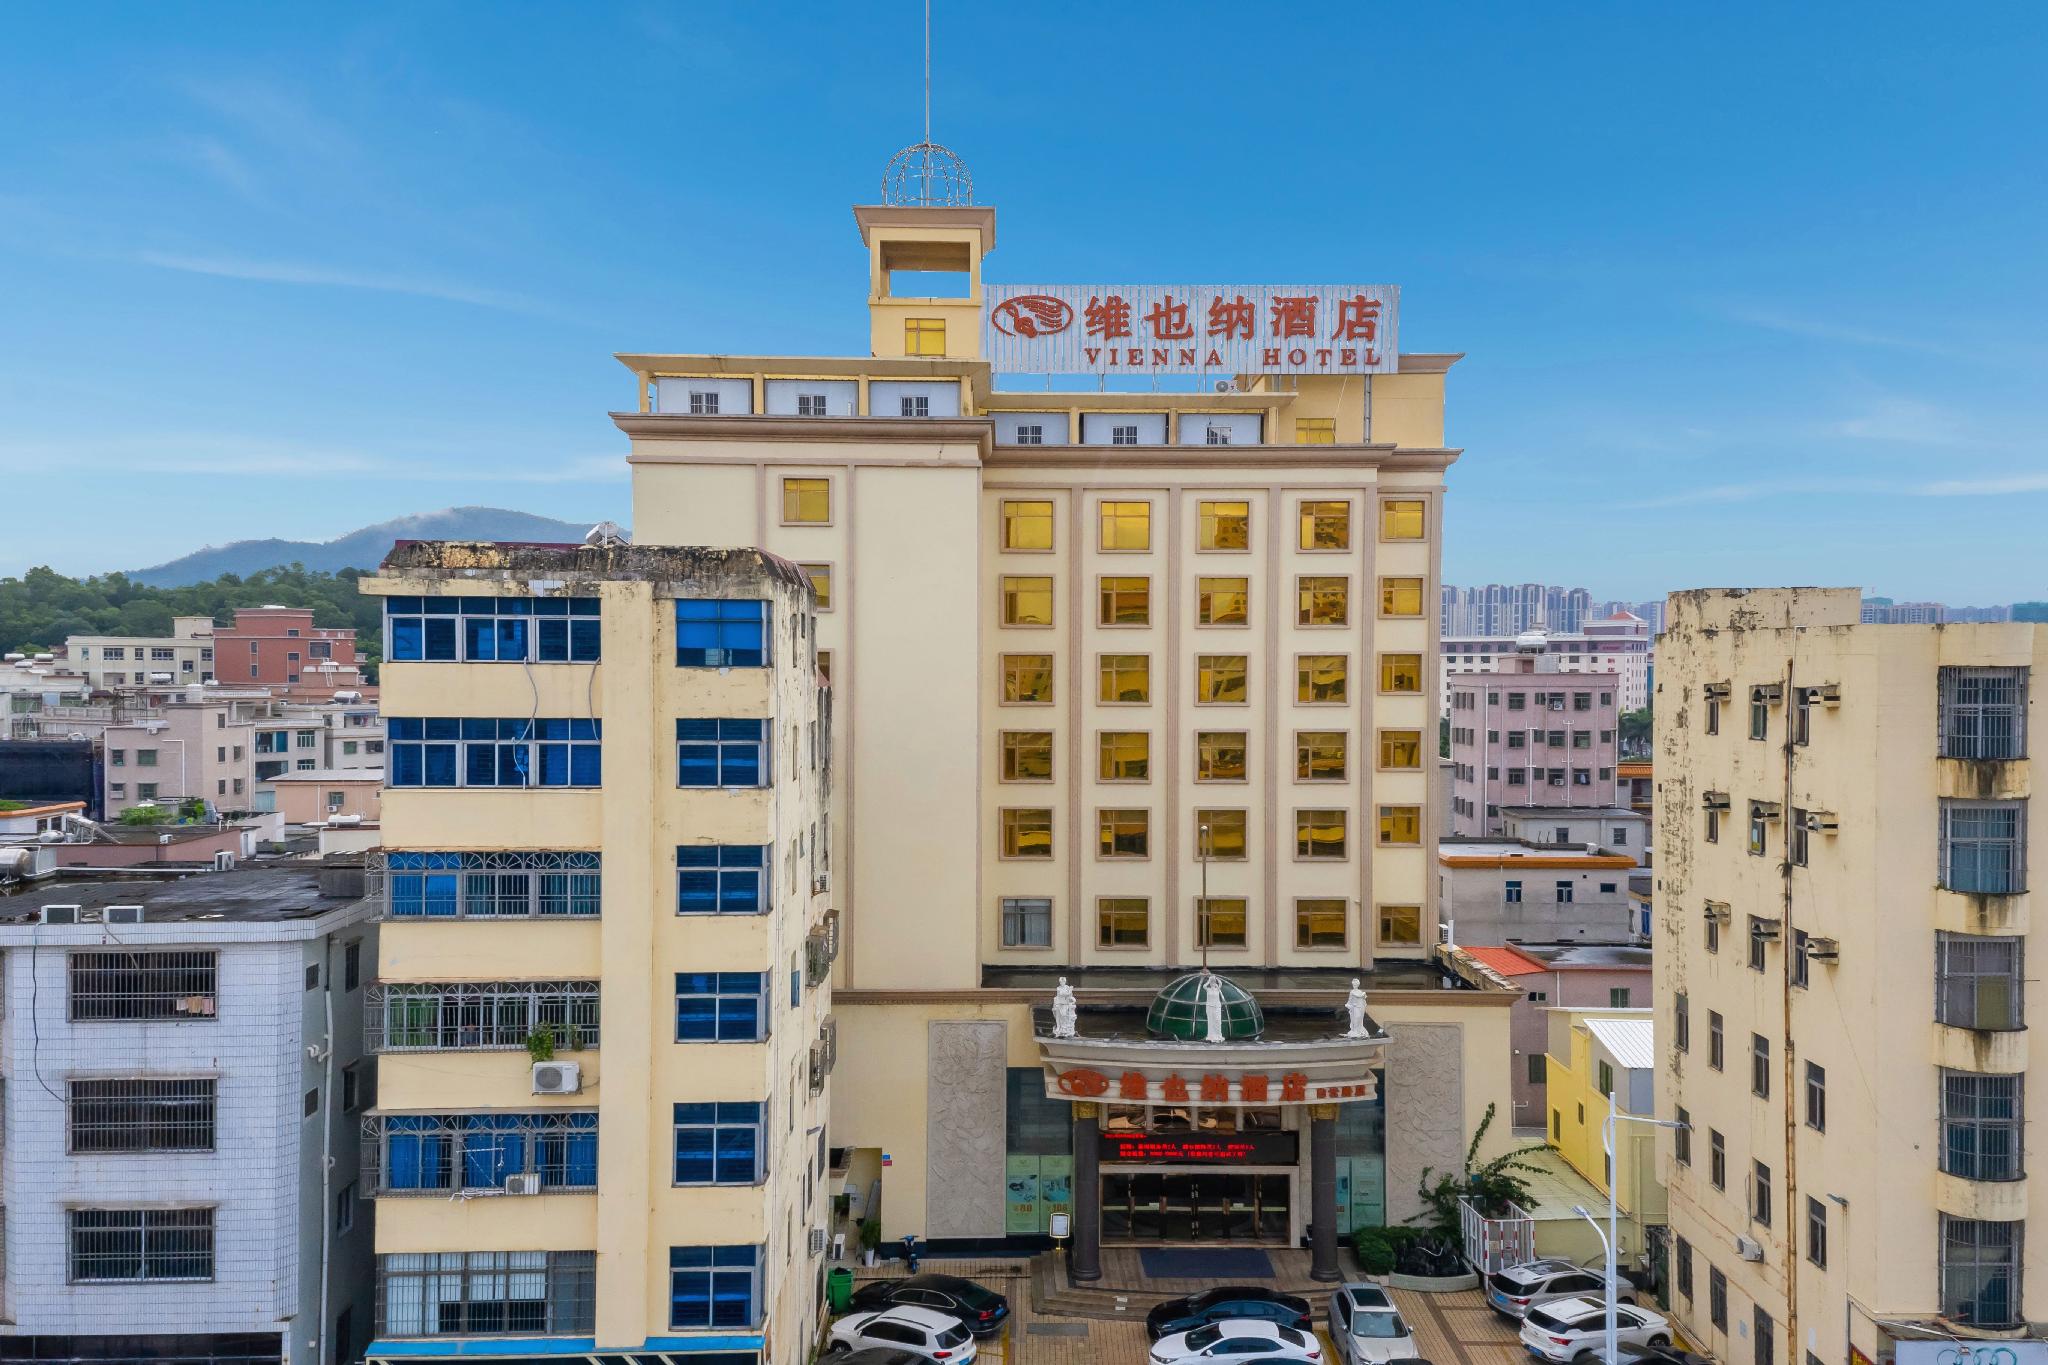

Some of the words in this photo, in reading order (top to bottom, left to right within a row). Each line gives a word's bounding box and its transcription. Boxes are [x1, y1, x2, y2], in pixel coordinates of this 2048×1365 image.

[1084, 295, 1381, 341] 维也纳酒店
[1085, 348, 1223, 366] VIENNA
[1263, 348, 1382, 366] HOTEL
[1120, 1072, 1307, 1102] 维也纳酒店
